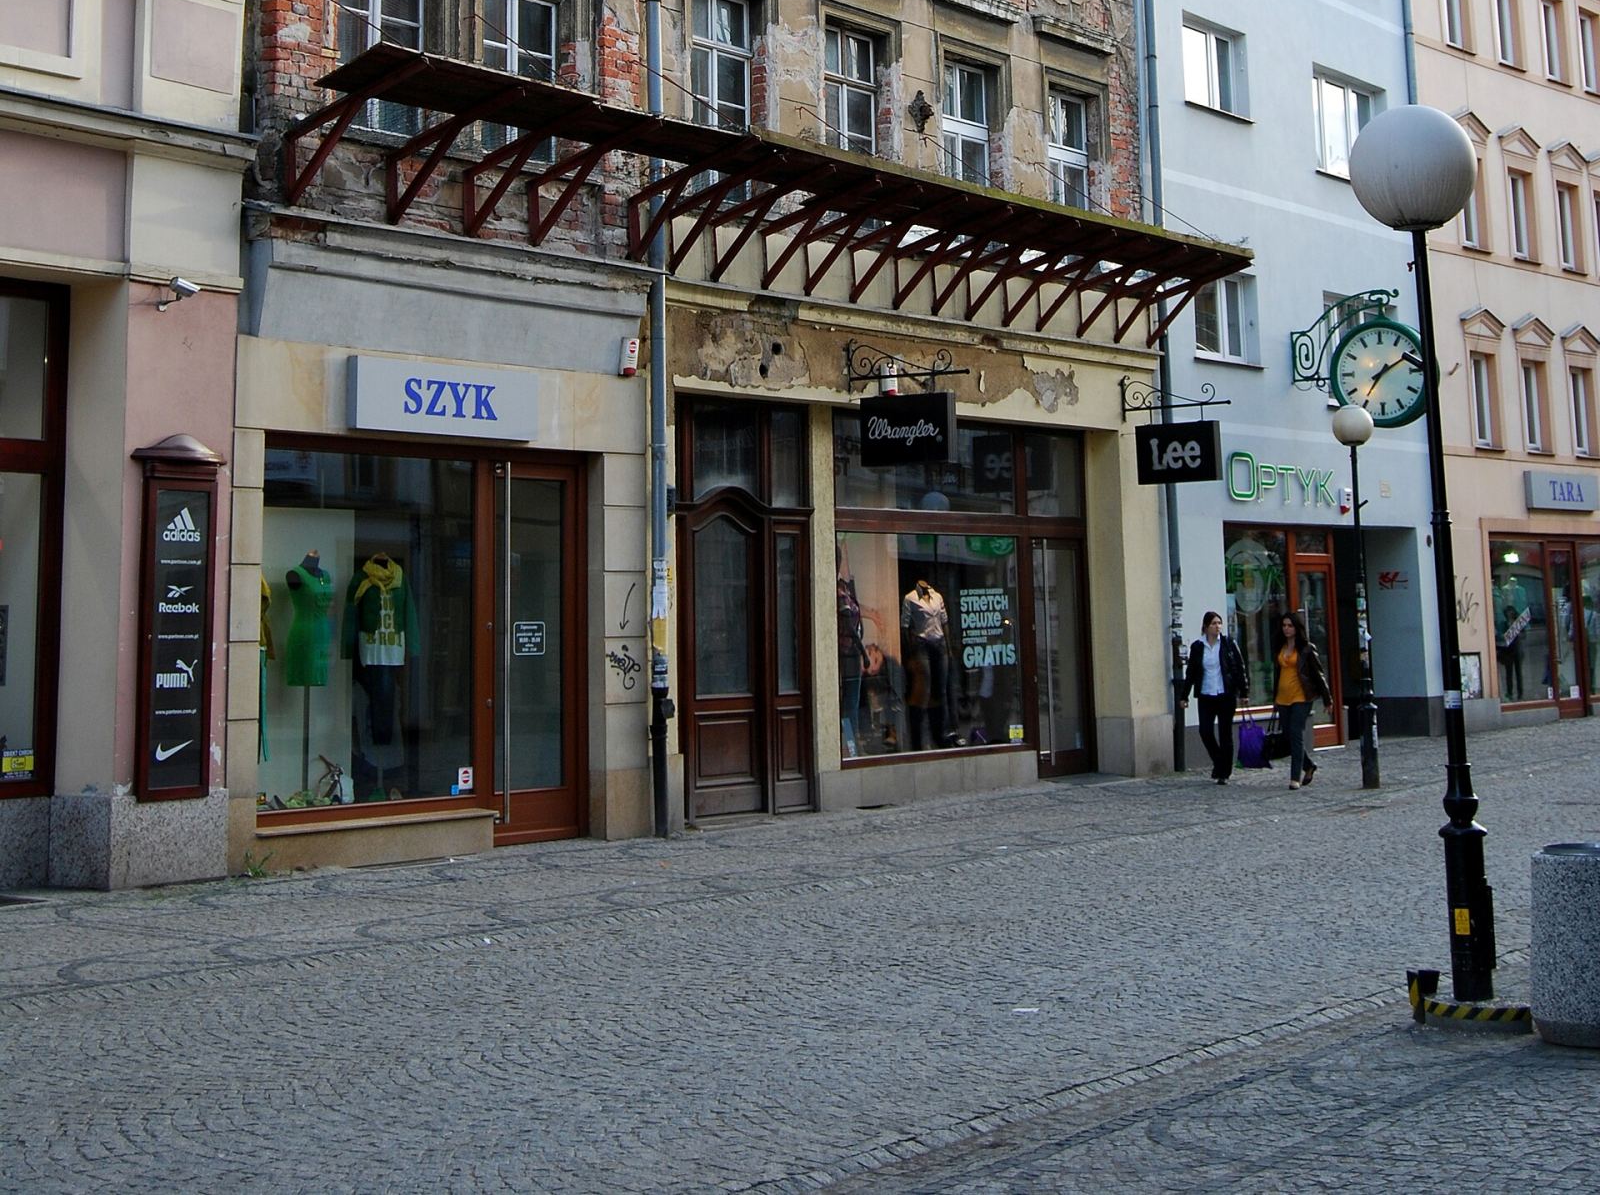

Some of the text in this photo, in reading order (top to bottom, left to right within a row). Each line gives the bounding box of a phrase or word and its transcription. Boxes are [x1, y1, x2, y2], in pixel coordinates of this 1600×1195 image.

[404, 378, 497, 420] SZYK
[868, 416, 940, 445] Wrangler
[1150, 439, 1201, 470] Lee
[1228, 451, 1336, 506] OPTYK
[1549, 480, 1584, 502] TARA
[163, 528, 200, 542] adidas
[158, 602, 200, 613] Reebok
[963, 644, 1016, 668] GRATIS
[156, 672, 188, 688] PUMA
